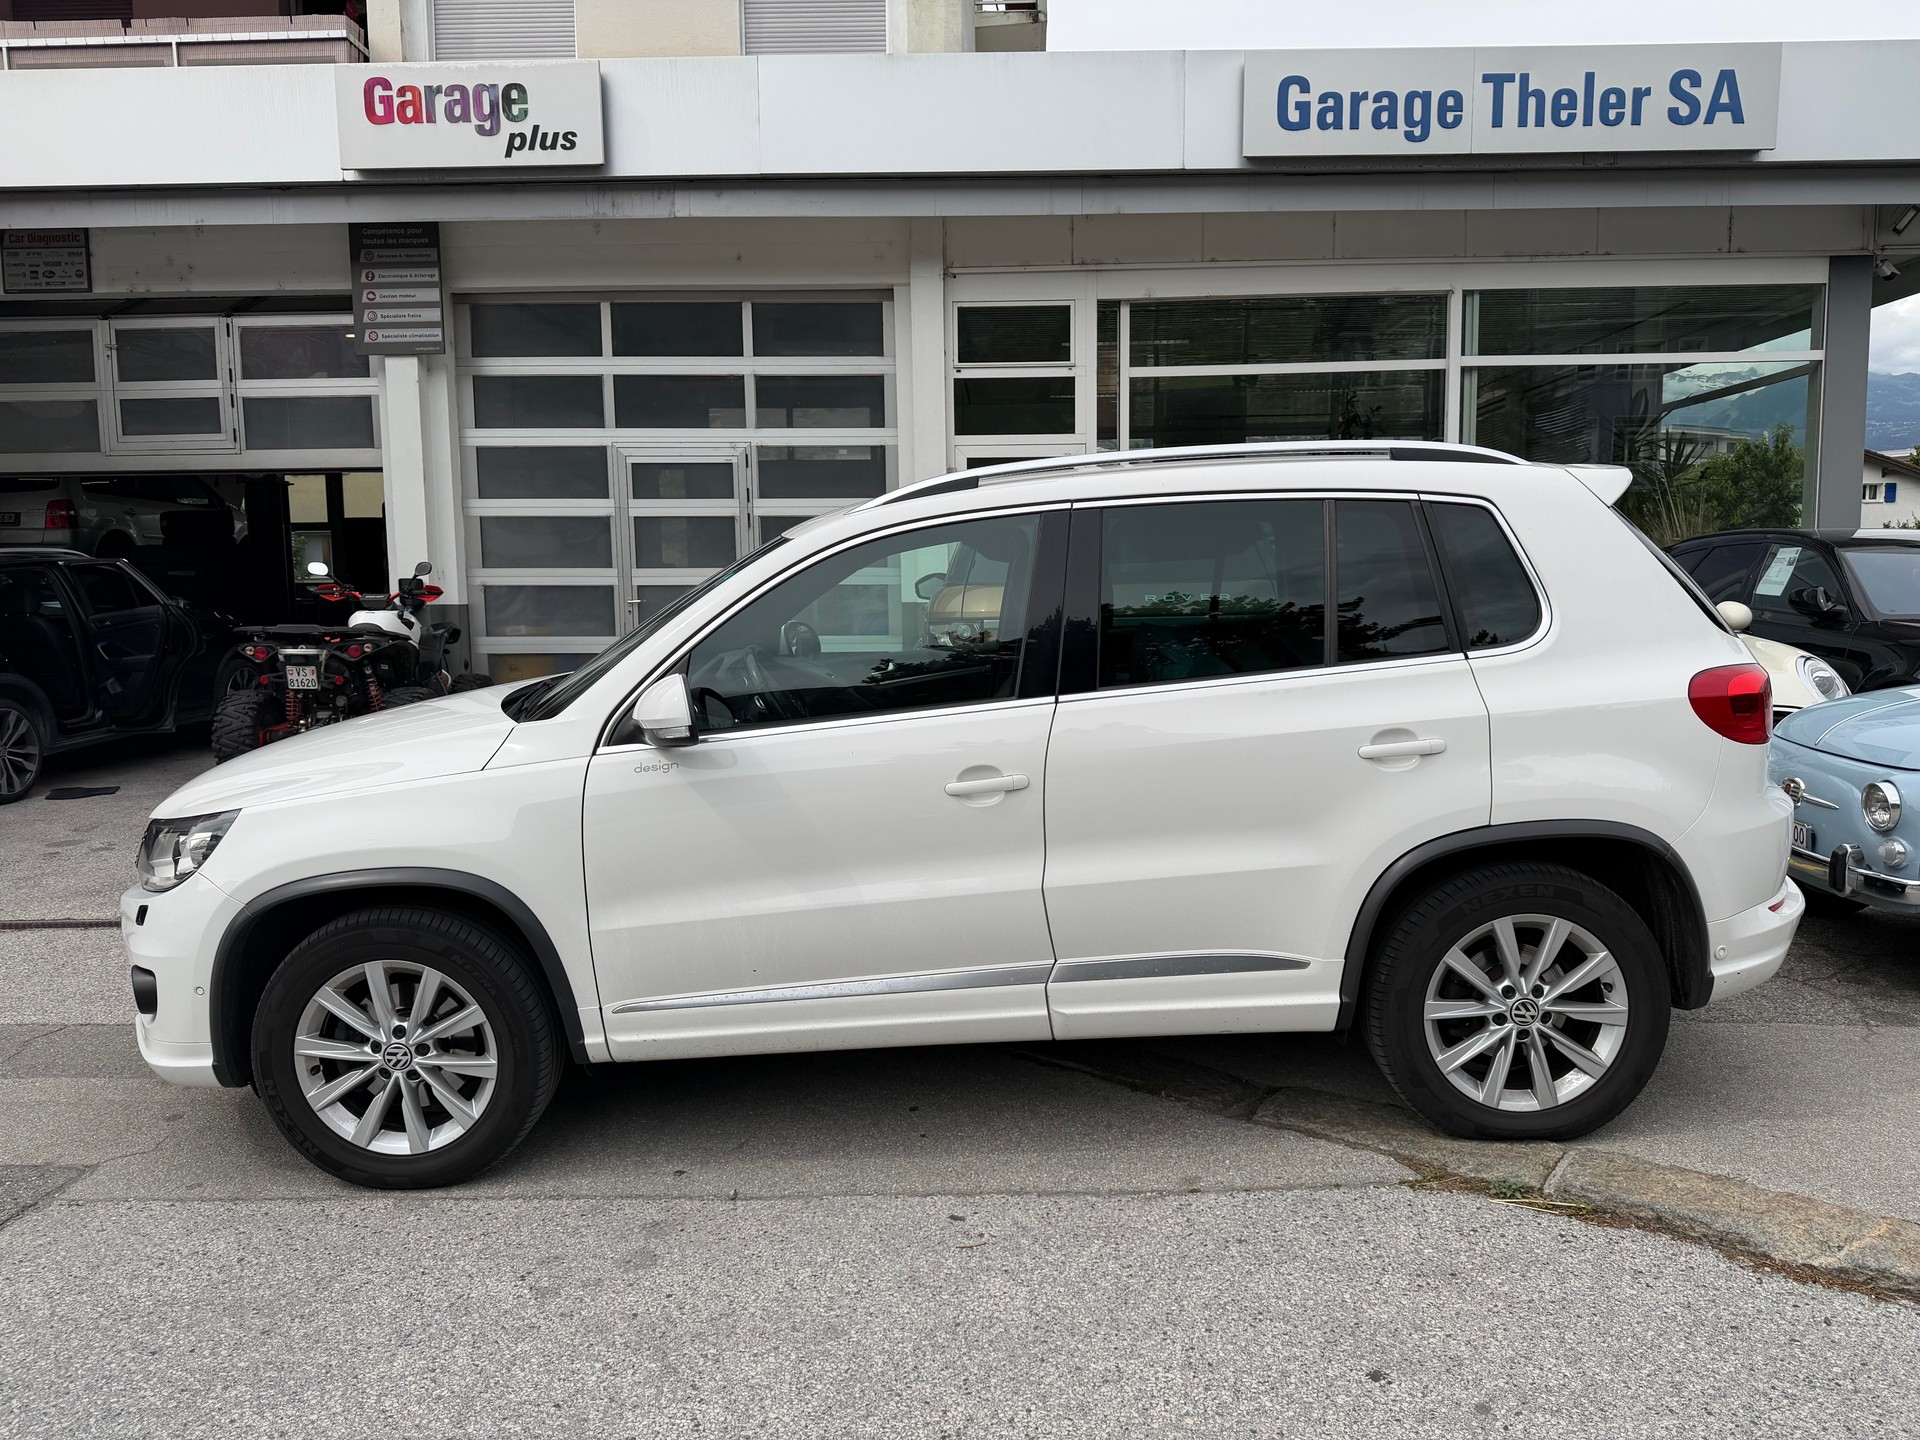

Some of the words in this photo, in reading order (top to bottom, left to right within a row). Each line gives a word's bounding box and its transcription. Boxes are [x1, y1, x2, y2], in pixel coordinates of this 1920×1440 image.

[363, 76, 529, 136] Garage
[1276, 74, 1464, 142] Garage
[1482, 71, 1651, 128] Theler
[1666, 68, 1745, 125] SA
[504, 125, 578, 158] plus
[362, 227, 405, 235] Compétence
[8, 234, 25, 244] Car
[28, 232, 80, 245] Diagnostic
[1144, 593, 1231, 602] ROVER
[296, 668, 307, 677] VS
[290, 679, 316, 688] 81620
[634, 760, 679, 774] design
[1461, 885, 1554, 915] NEXEN
[264, 1079, 321, 1156] NEXEN
